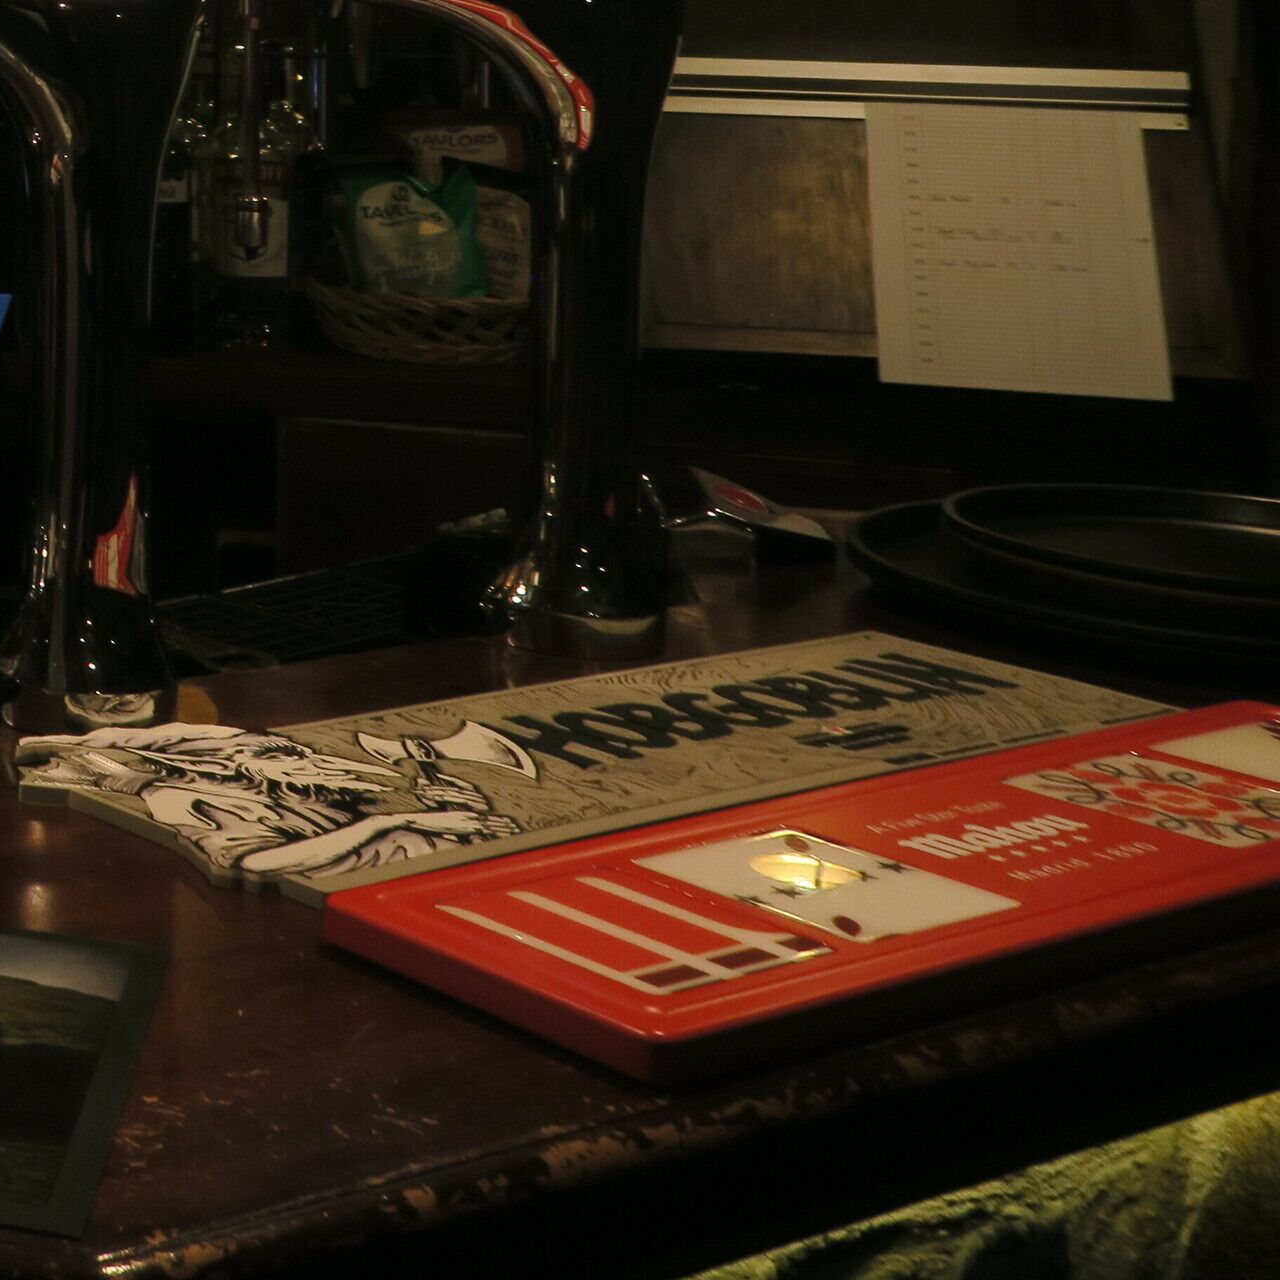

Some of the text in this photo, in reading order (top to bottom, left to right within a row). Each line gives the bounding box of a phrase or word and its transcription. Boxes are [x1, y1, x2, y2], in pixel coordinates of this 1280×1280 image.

[503, 651, 1020, 771] HOBGOBLIN
[897, 813, 1090, 861] Mahou
[1006, 856, 1091, 882] Madrid
